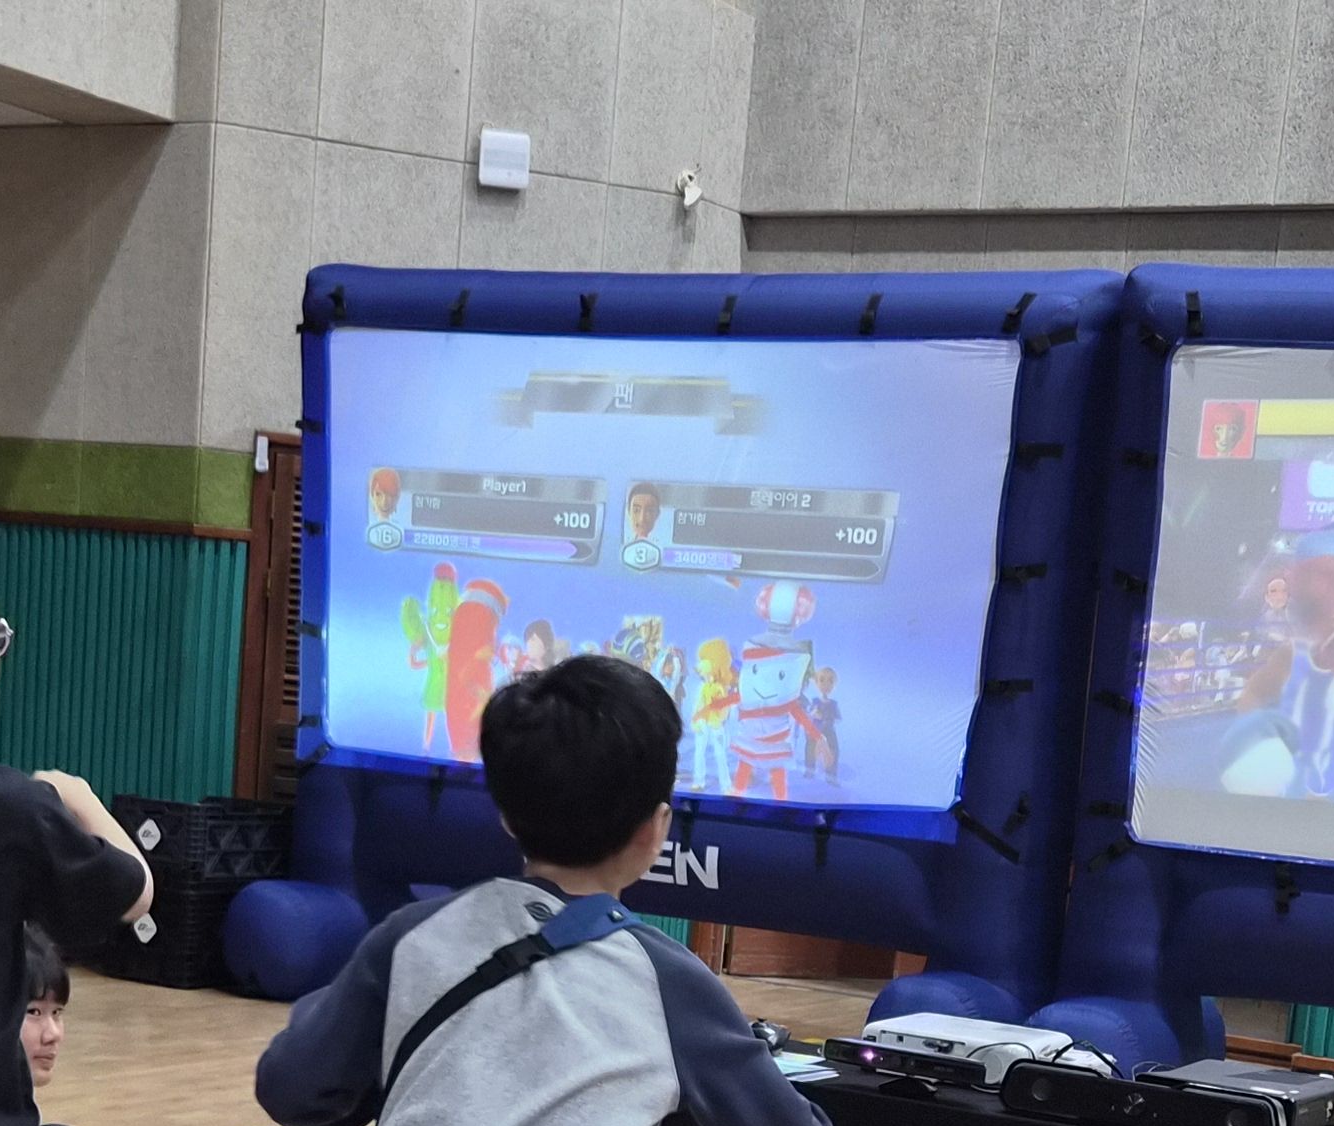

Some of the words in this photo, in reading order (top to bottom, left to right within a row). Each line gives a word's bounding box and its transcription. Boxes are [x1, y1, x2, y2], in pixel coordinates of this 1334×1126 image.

[482, 477, 526, 494] Player1
[801, 494, 812, 508] 2
[553, 511, 590, 529] +100
[375, 529, 392, 544] 16
[835, 527, 878, 545] +100
[635, 548, 647, 563] 3
